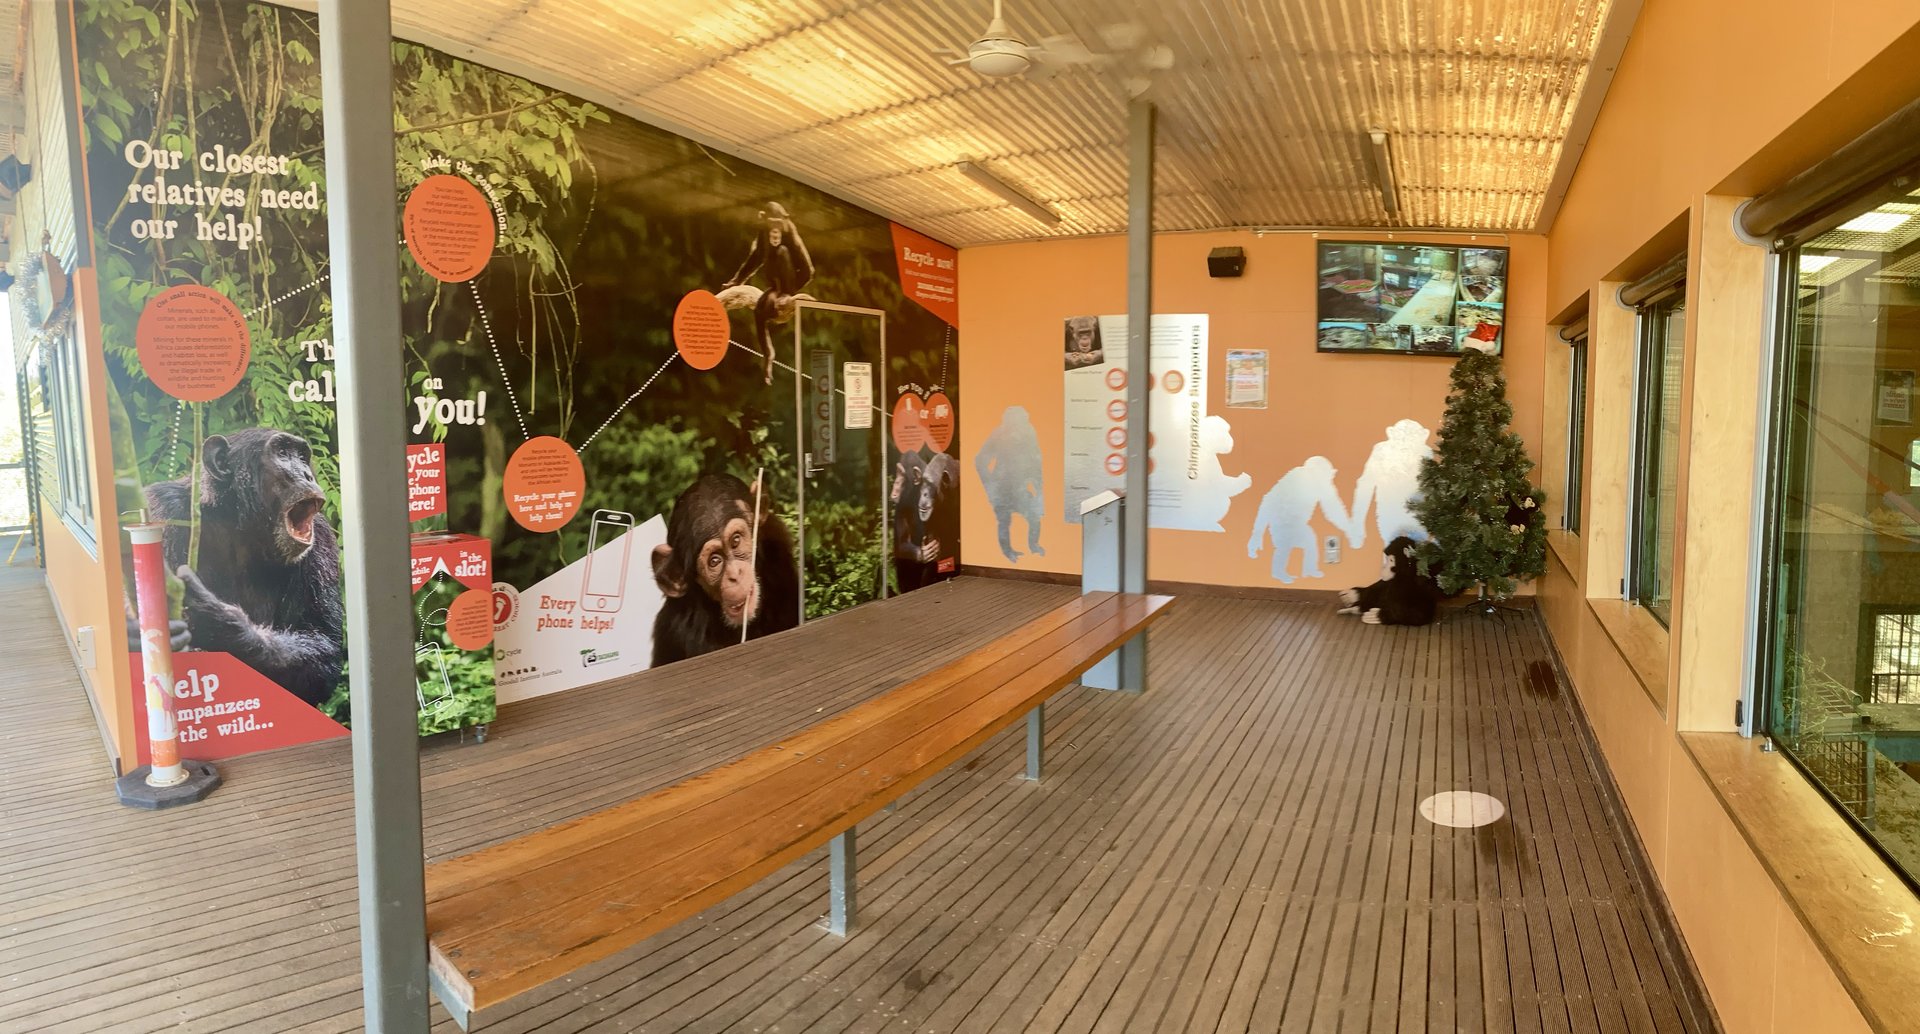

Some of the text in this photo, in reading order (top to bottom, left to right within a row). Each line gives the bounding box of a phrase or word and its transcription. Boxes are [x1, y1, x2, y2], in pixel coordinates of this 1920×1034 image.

[125, 140, 289, 175] Our closest
[421, 155, 451, 171] Make
[456, 161, 473, 174] the
[128, 176, 319, 210] relatives need
[131, 212, 263, 250] our help!
[904, 247, 934, 267] Recycle
[300, 339, 335, 362] Th
[288, 370, 443, 402] cal on
[413, 390, 487, 435] you!
[1188, 325, 1202, 480] Chimpanzee Supporters
[407, 447, 440, 473] ycle
[415, 469, 440, 481] your
[409, 484, 440, 499] phone
[514, 490, 576, 503] Recycle your phone
[535, 502, 547, 510] and
[550, 502, 563, 510] help
[529, 514, 543, 523] help
[418, 556, 433, 565] your
[460, 550, 468, 558] in
[468, 553, 482, 563] the
[412, 566, 430, 576] obile
[454, 560, 486, 577] slot!
[539, 595, 576, 614] Every
[536, 614, 615, 634] phone helps!
[174, 669, 219, 702] elp
[177, 698, 260, 725] mpanzees
[179, 714, 274, 743] the wild...
